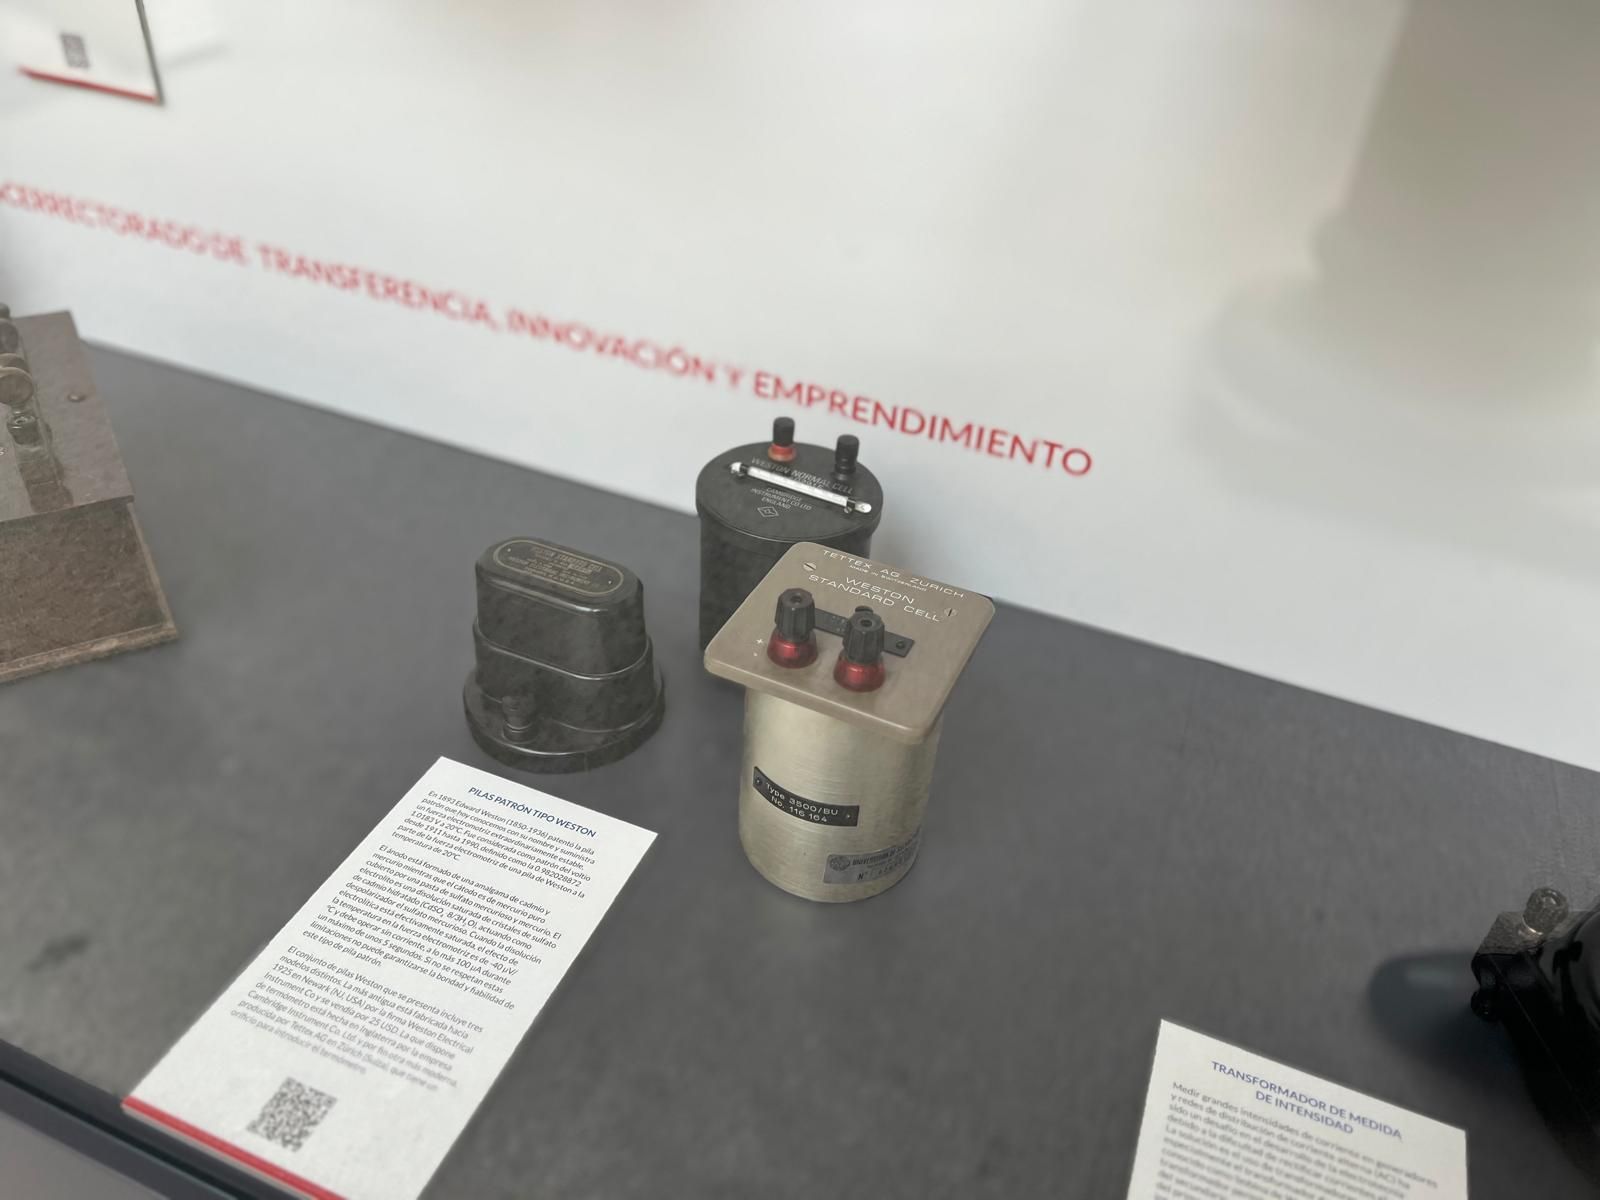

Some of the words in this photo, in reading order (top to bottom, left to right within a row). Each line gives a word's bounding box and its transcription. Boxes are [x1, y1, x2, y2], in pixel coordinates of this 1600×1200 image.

[257, 243, 501, 331] TRANSFERENCIA,
[507, 308, 716, 383] INNOVACIÓN
[725, 364, 744, 389] Y
[753, 371, 1093, 477] EMPRENDIMIENTO
[808, 574, 895, 607] STANDARD
[903, 605, 940, 622] CELL
[823, 550, 873, 569] TETTEX
[880, 568, 901, 578] AG
[909, 577, 965, 598] ZURICH
[846, 577, 915, 604] WESTON
[420, 797, 445, 810] patrón
[443, 806, 457, 815] que
[455, 809, 471, 819] hoy
[468, 815, 507, 832] conocemos
[505, 828, 520, 837] con
[527, 836, 555, 850] nombre
[558, 848, 595, 864] suministra
[436, 794, 456, 804] 1893
[453, 800, 481, 814] Edward
[479, 809, 506, 823] Weston
[504, 818, 549, 839] (1850-1936)
[546, 834, 575, 848] patentó
[579, 846, 595, 855] pila
[467, 786, 495, 801] PILAS
[493, 795, 533, 814] PATRÓN
[531, 809, 555, 823] TIPO
[554, 817, 597, 837] WESTON
[766, 782, 786, 800] Type
[789, 798, 839, 816] 3500/BU
[771, 796, 785, 809] No.
[789, 806, 805, 817] 116
[390, 830, 433, 851] temperatura
[395, 824, 417, 836] parte
[431, 836, 454, 849] fuerza
[452, 845, 500, 866] electromotriz
[507, 866, 522, 874] una
[520, 870, 536, 880] pila
[544, 878, 573, 894] Weston
[403, 817, 425, 828] desde
[423, 824, 443, 835] 1911
[440, 830, 461, 842] hasta
[479, 845, 508, 860] definido
[507, 856, 527, 867] como
[424, 806, 447, 819] fuerza
[445, 815, 491, 835] electromotriz
[489, 831, 559, 860] extraordinariamente
[462, 829, 477, 839] Fue
[475, 835, 517, 854] considerada
[515, 850, 536, 861] como
[534, 857, 560, 870] patrón
[558, 865, 572, 874] del
[570, 869, 591, 881] voltio
[358, 867, 395, 885] electrolito
[414, 889, 452, 907] disolución
[449, 903, 482, 919] saturada
[490, 919, 522, 935] cristales
[530, 934, 557, 949] sulfato
[360, 877, 387, 891] cadmio
[385, 886, 421, 905] hidratado
[477, 924, 512, 941] actuando
[364, 859, 395, 874] cubierto
[418, 880, 440, 892] pasta
[448, 891, 474, 906] sulfato
[472, 901, 513, 921] mercurioso
[371, 852, 403, 868] mercurio
[401, 863, 433, 879] mientras
[452, 883, 479, 897] cátodo
[495, 900, 528, 917] mercurio
[385, 847, 408, 860] ánodo
[421, 861, 452, 877] formado
[473, 881, 510, 899] amalgama
[518, 899, 545, 913] cadmio
[337, 889, 380, 910] electrolítica
[393, 912, 445, 936] efectivamente
[483, 948, 509, 962] efecto
[337, 900, 382, 922] temperatura
[397, 923, 422, 938] fuerza
[420, 932, 471, 957] electromotriz
[344, 881, 397, 906] despolarizador
[402, 904, 428, 919] sulfato
[468, 930, 498, 946] Cuando
[503, 944, 542, 964] disolución
[355, 919, 381, 932] operar
[480, 968, 512, 985] durante
[309, 920, 353, 942] limitaciones
[359, 942, 385, 957] puede
[382, 952, 429, 975] garantizarse
[434, 972, 466, 989] bondad
[468, 986, 505, 1006] fiabilidad
[326, 917, 356, 933] máximo
[449, 967, 484, 986] respetan
[482, 981, 504, 994] estas
[278, 954, 311, 973] modelos
[366, 992, 397, 1009] antigua
[411, 1010, 448, 1031] fabricada
[445, 1024, 470, 1040] hacia
[294, 949, 328, 967] conjunto
[334, 966, 355, 979] pilas
[353, 972, 384, 991] Weston
[404, 996, 441, 1015] presenta
[438, 1008, 468, 1027] incluye
[300, 975, 331, 993] Newark
[384, 1011, 408, 1026] firma
[406, 1019, 439, 1038] Weston
[435, 1032, 474, 1054] Electrical
[1211, 1060, 1326, 1112] TRANSFORMADOR
[1328, 1103, 1346, 1119] DE
[1348, 1110, 1402, 1140] MEDIDA
[1255, 1089, 1272, 1105] DE
[1274, 1096, 1353, 1134] INTENSIDAD
